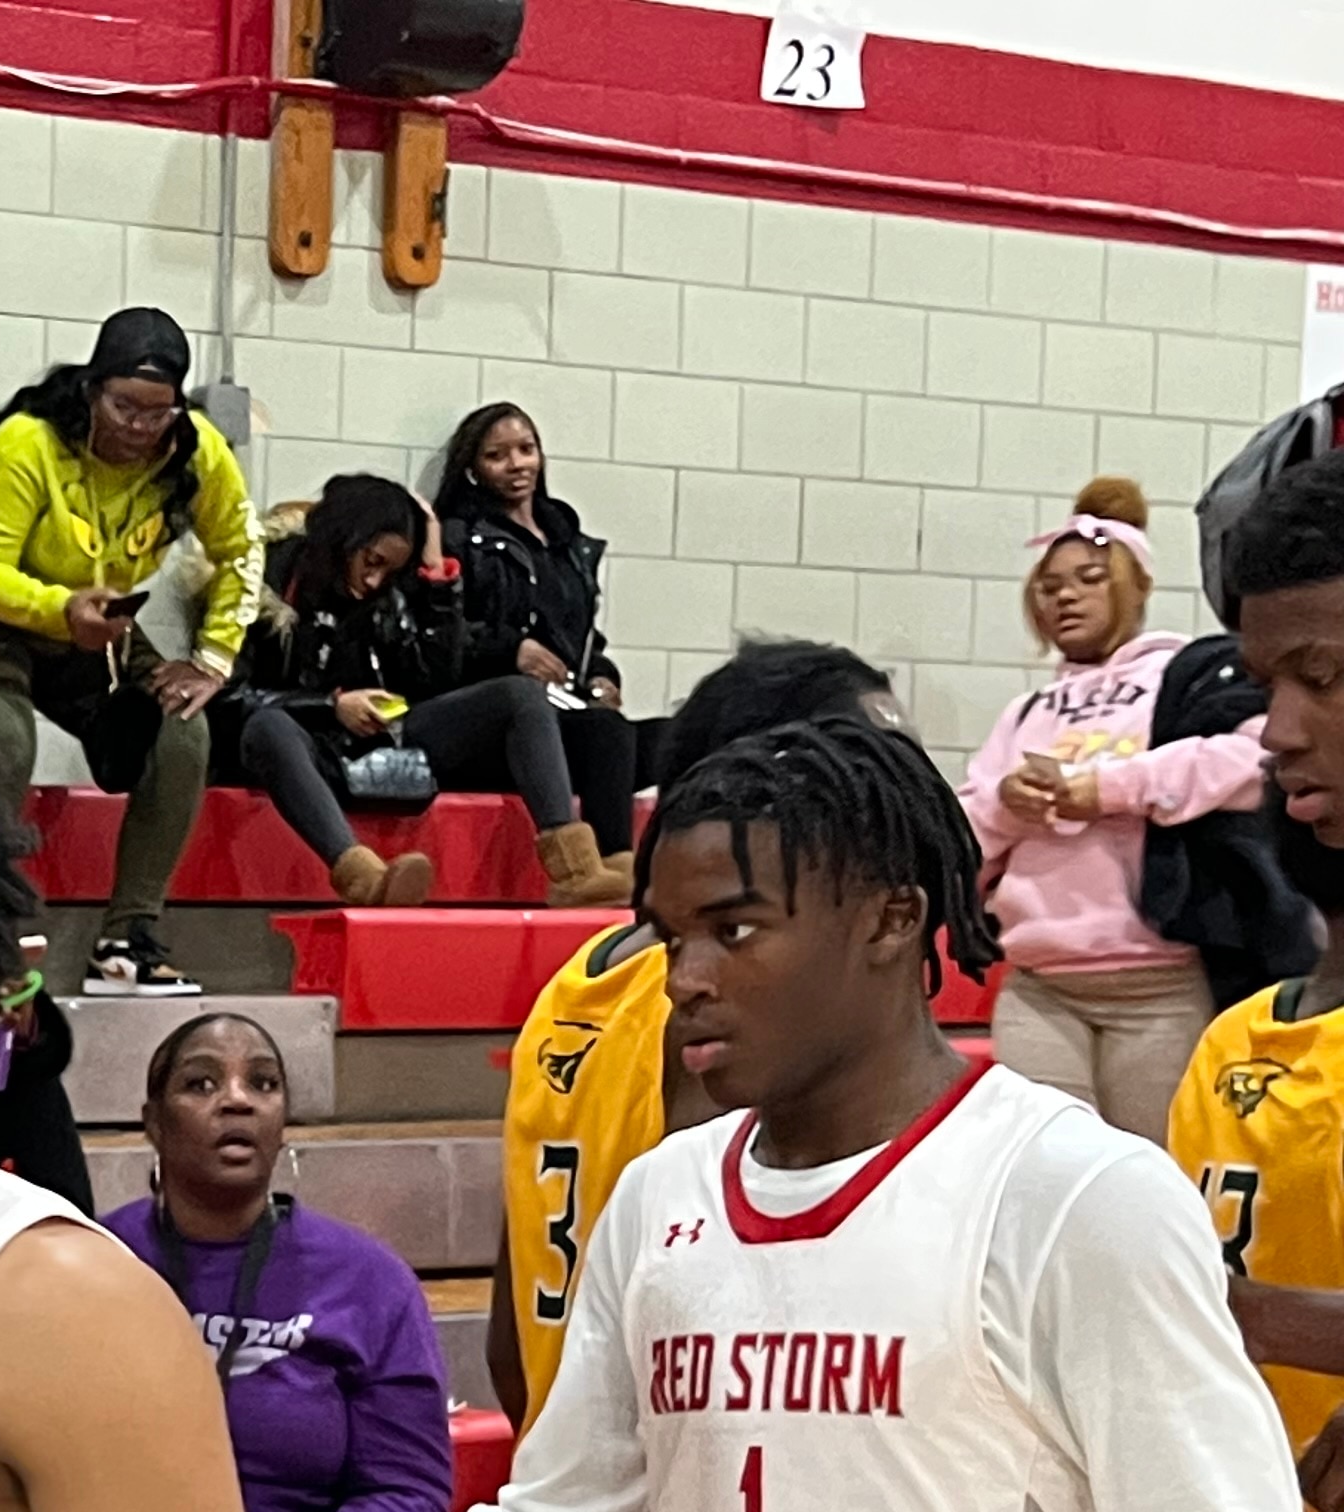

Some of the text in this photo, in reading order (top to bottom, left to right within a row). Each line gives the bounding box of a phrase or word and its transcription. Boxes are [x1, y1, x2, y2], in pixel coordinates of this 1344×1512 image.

[773, 38, 836, 101] 23
[534, 1139, 582, 1328] 3
[650, 1331, 906, 1418] RED STORM
